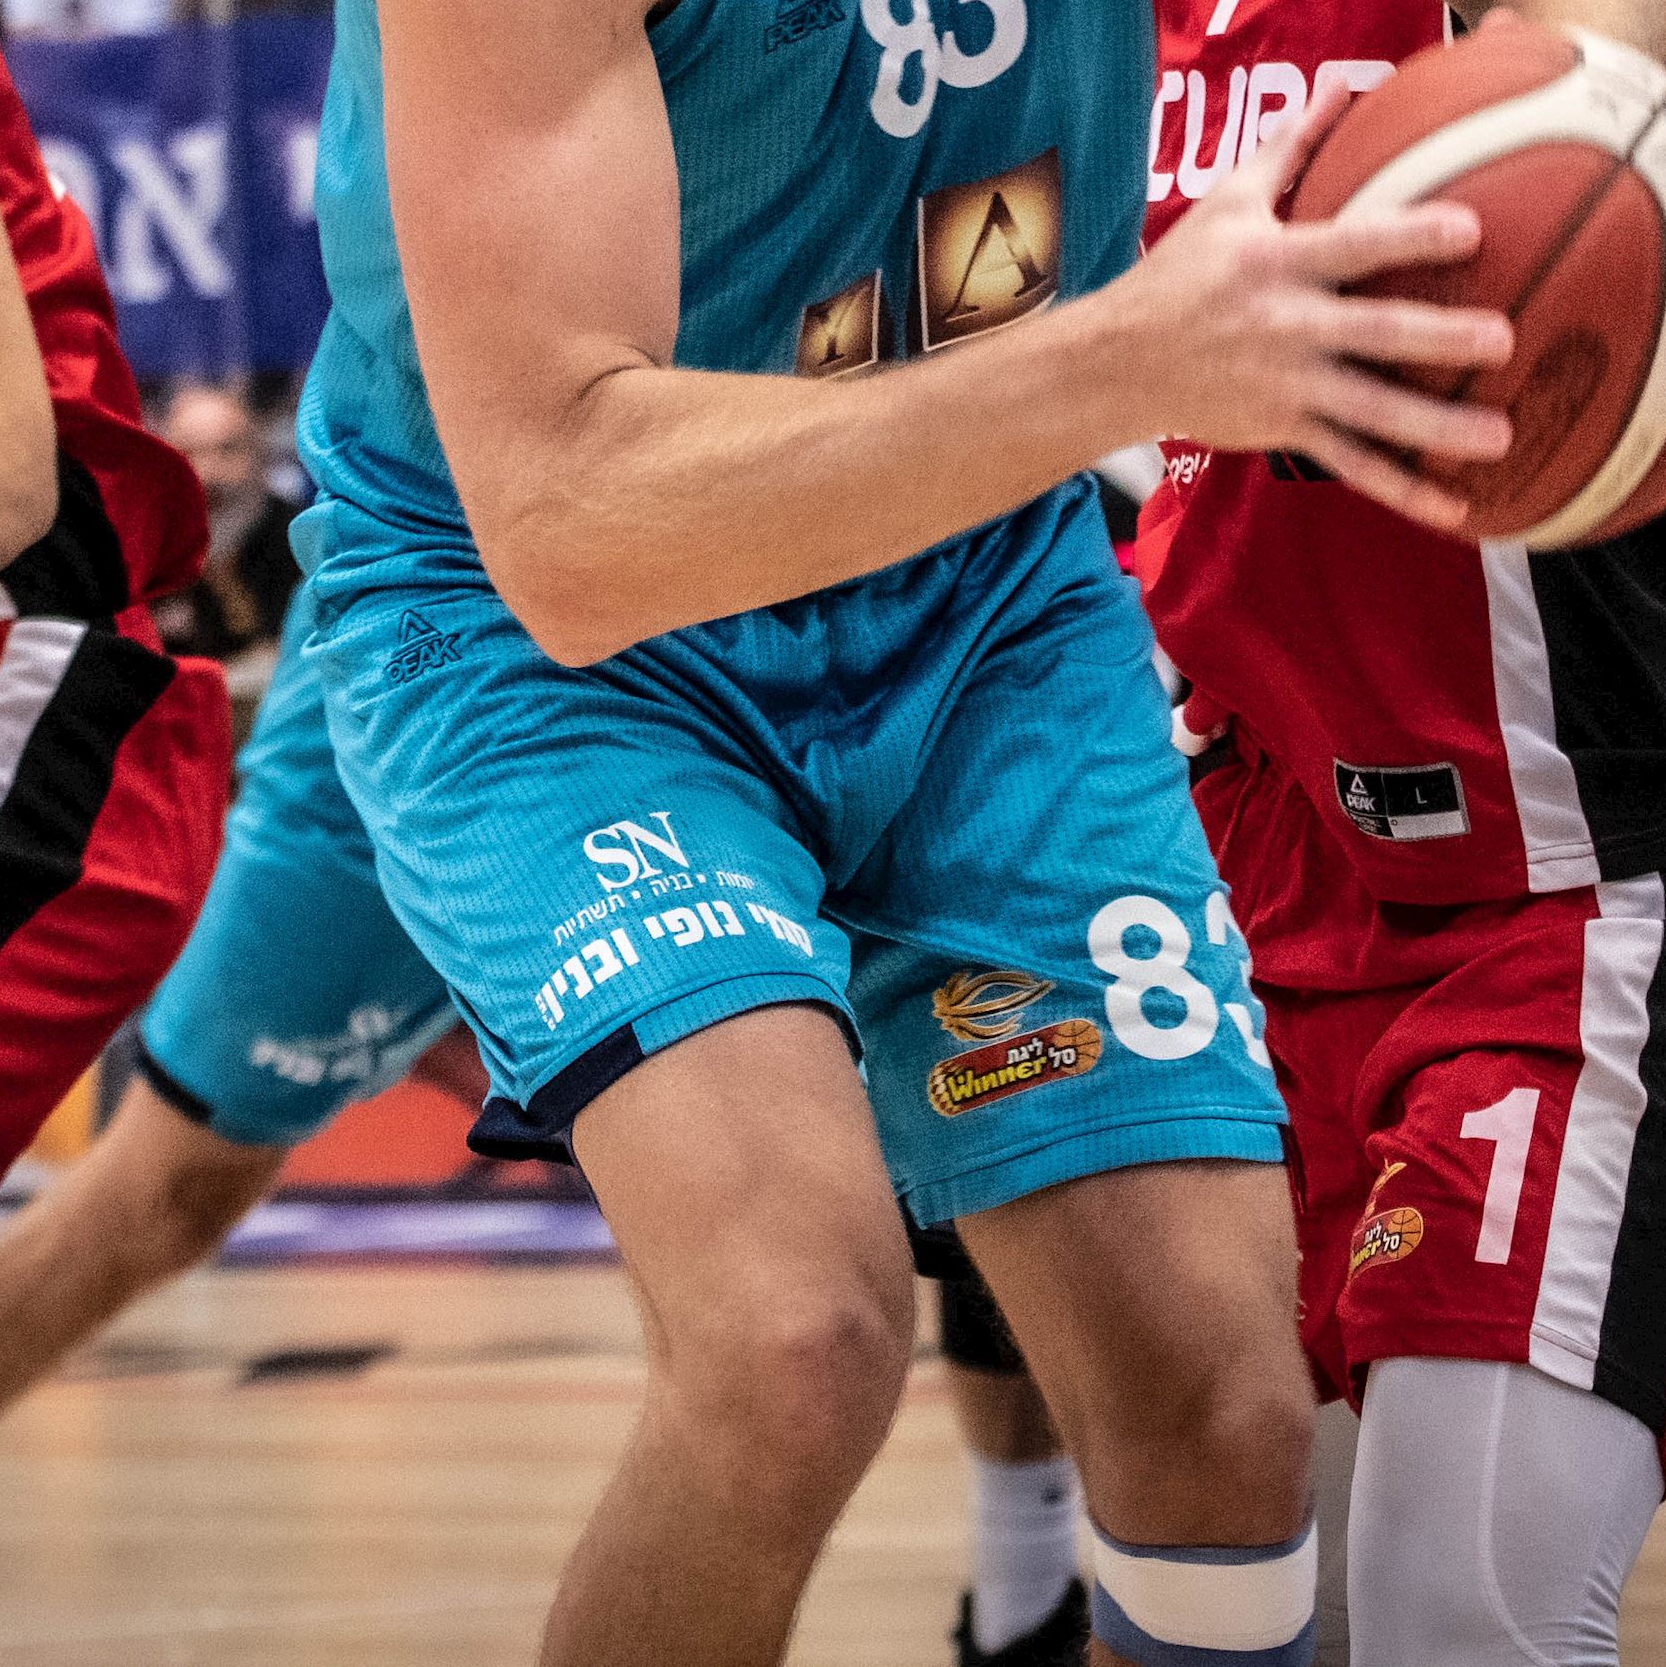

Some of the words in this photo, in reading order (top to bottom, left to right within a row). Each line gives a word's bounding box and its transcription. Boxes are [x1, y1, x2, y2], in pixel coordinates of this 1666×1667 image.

[383, 633, 463, 684] PEAK
[1345, 792, 1377, 812] PEAK
[1415, 786, 1428, 805] L
[582, 810, 690, 894] SN
[648, 871, 694, 897] בניה
[552, 893, 627, 947] תשתיות
[642, 899, 746, 948] נופי
[1005, 1036, 1044, 1066] ליגת
[1046, 1045, 1077, 1069] סל
[944, 1056, 1048, 1103] Winner
[1459, 1086, 1541, 1265] 1
[1382, 1231, 1401, 1252] סל
